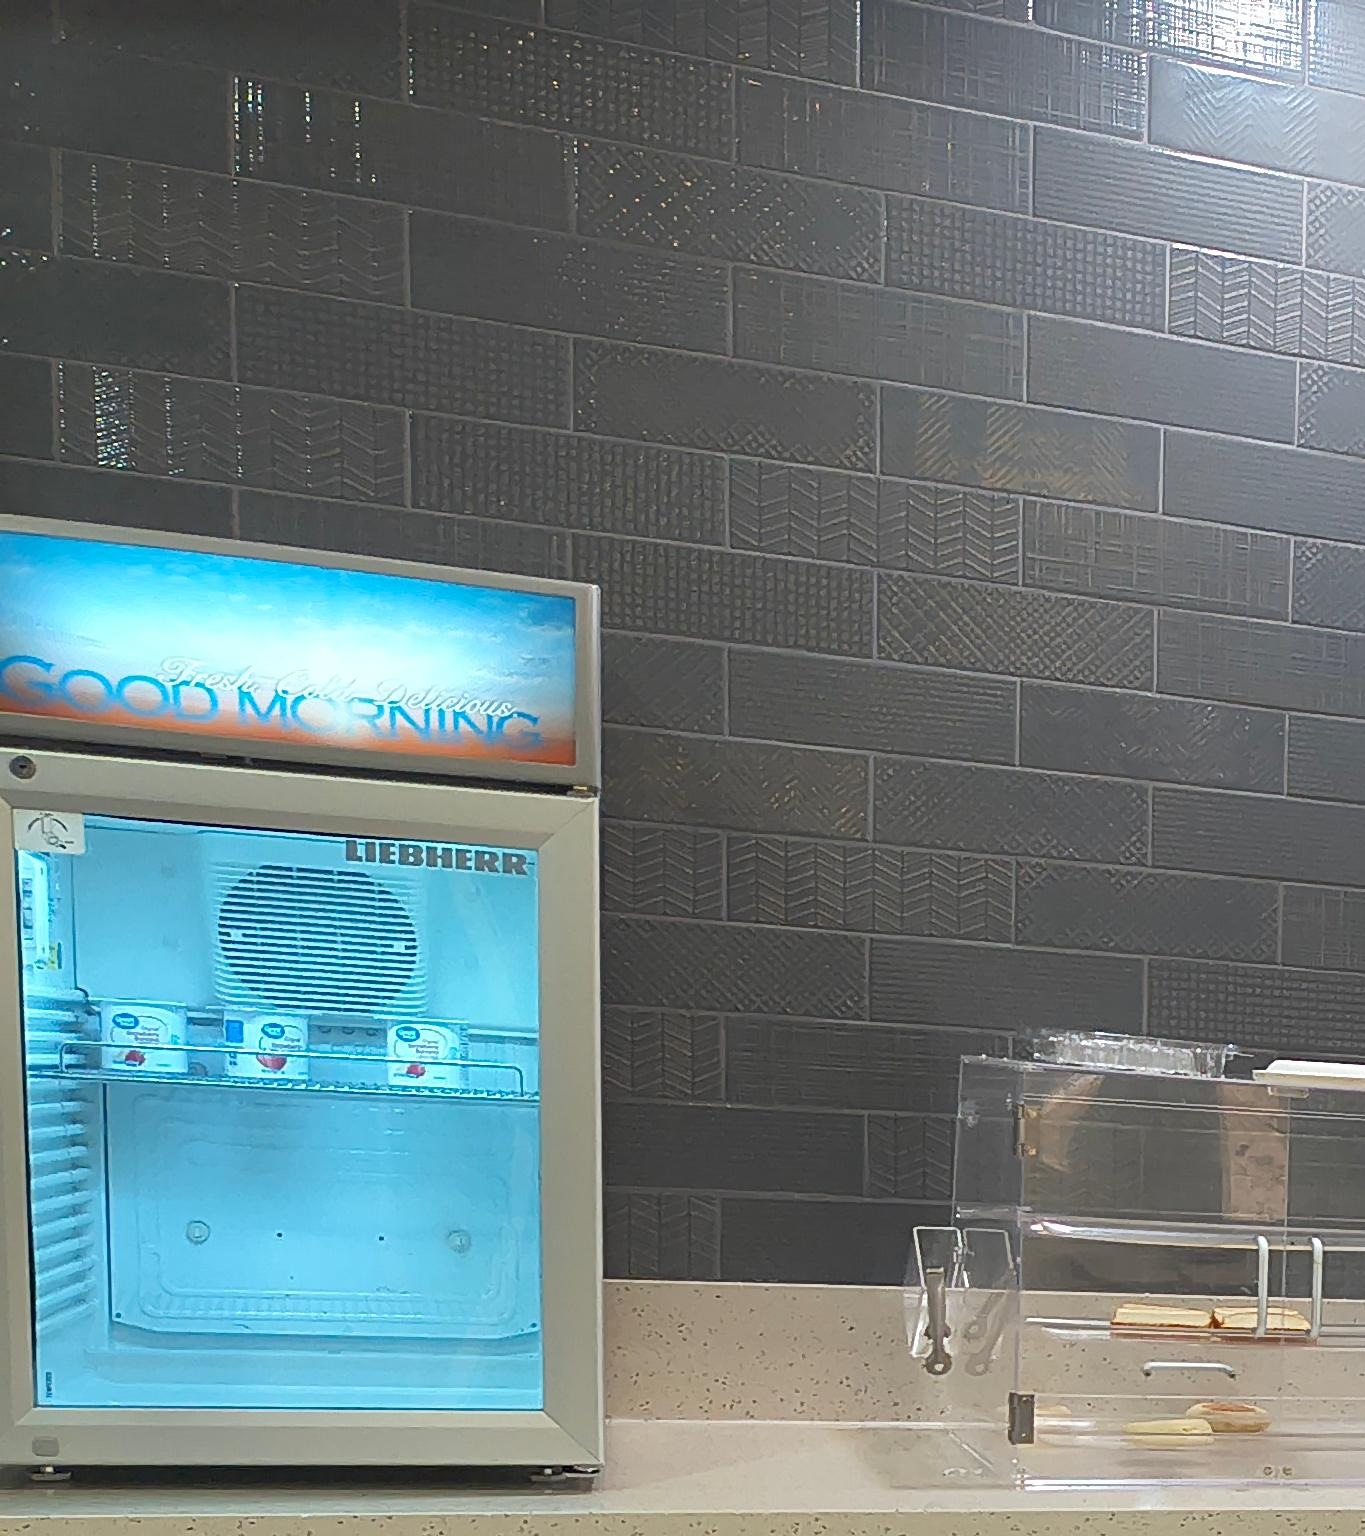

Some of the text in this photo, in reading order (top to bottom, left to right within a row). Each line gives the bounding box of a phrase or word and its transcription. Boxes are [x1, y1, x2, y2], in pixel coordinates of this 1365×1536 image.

[0, 655, 543, 748] GOOD MORNING
[345, 839, 528, 875] LIEBHERR
